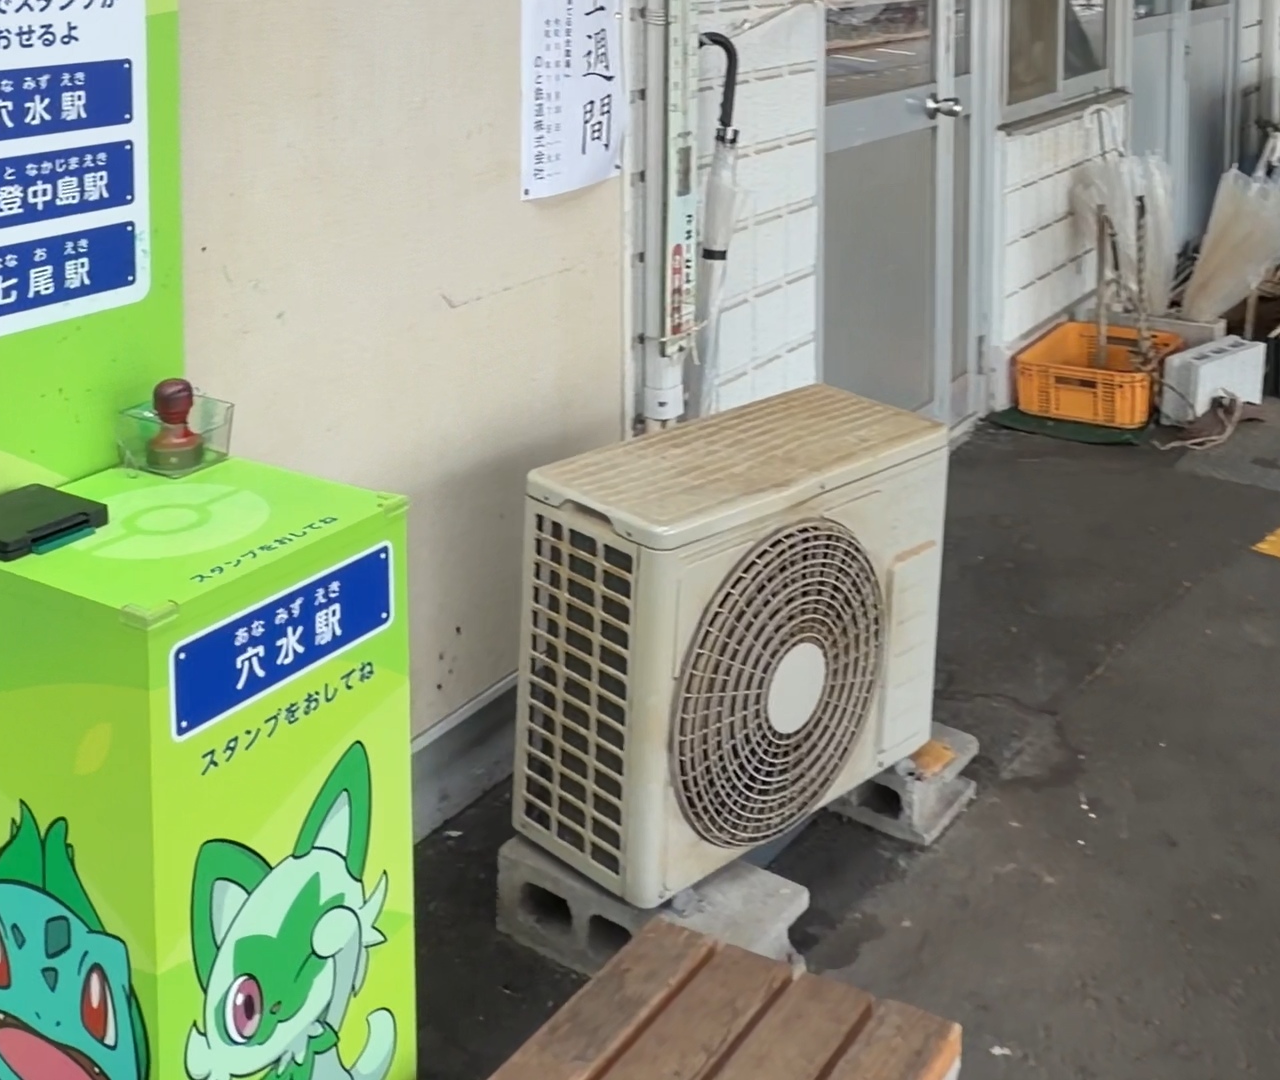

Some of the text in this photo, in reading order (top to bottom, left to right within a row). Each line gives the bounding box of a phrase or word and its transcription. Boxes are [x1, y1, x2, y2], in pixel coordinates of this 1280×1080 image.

[235, 603, 342, 690] 穴水駅
[200, 662, 375, 776] スタンプをおしてね
